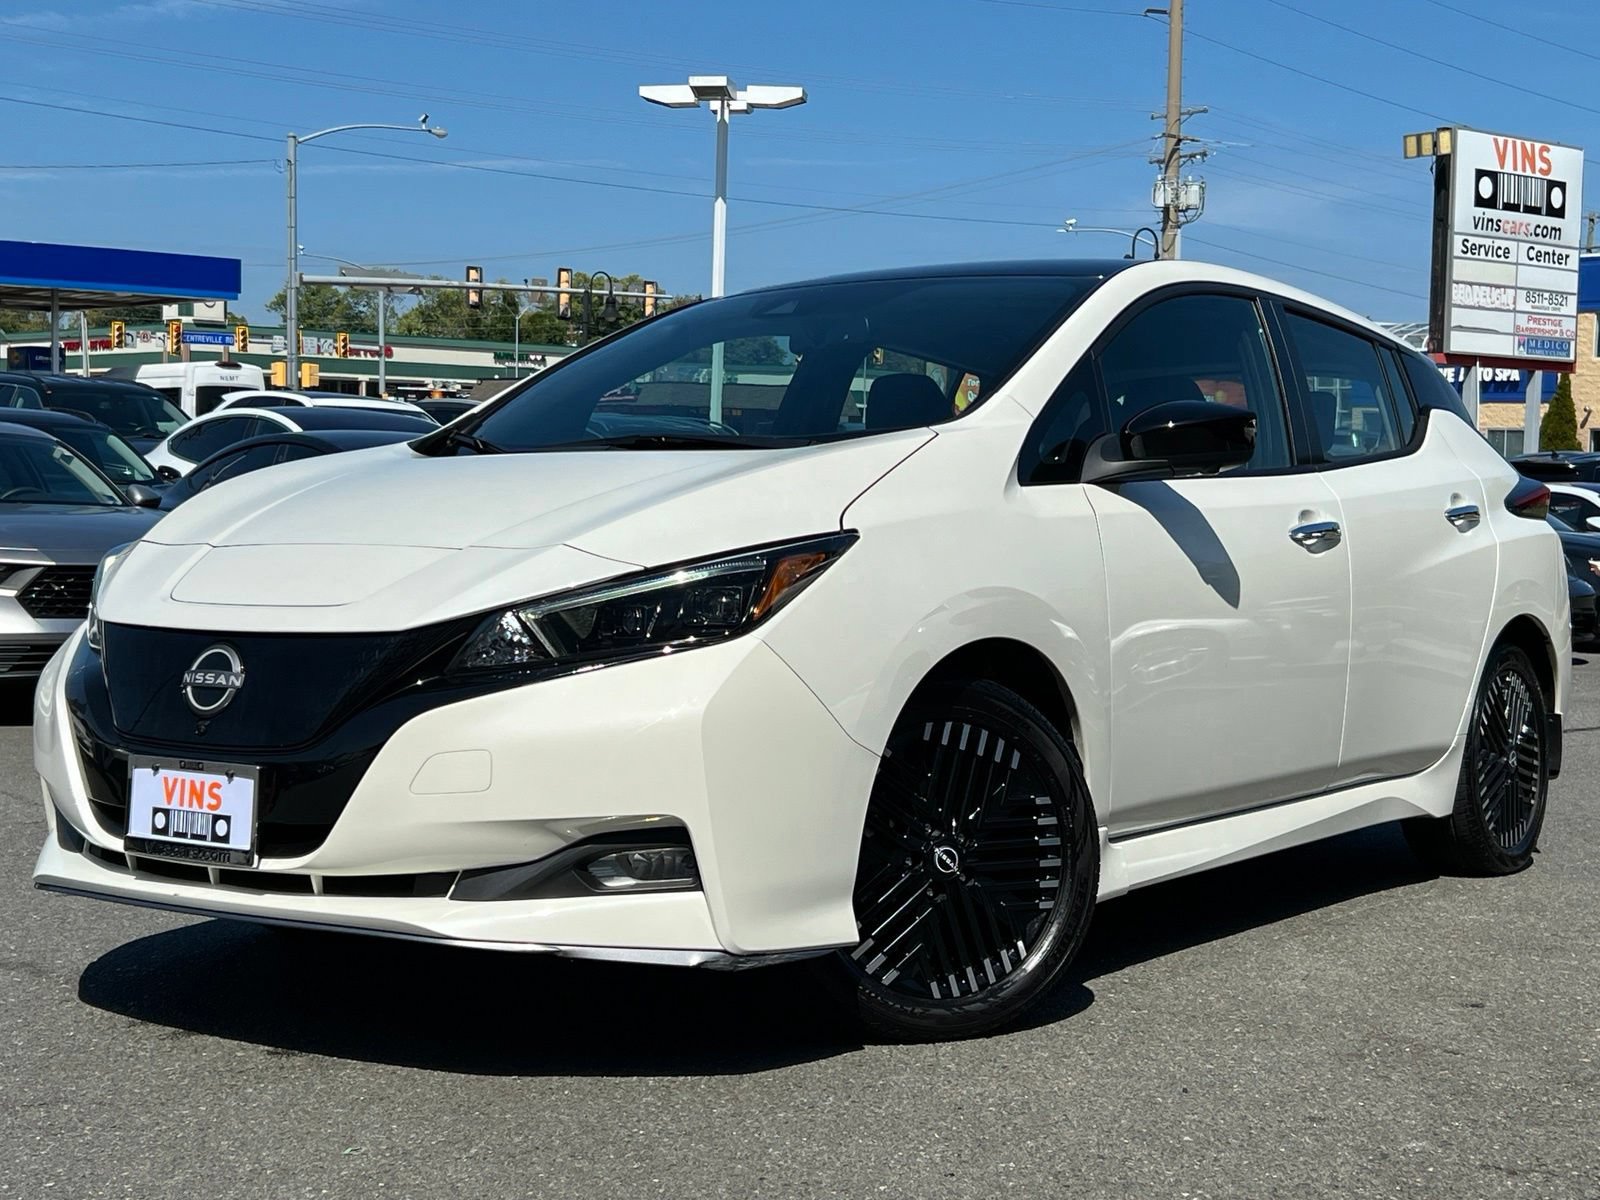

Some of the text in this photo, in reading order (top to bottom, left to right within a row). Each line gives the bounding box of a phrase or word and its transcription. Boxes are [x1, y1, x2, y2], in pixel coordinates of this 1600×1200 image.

[1492, 137, 1552, 176] VINS
[1473, 211, 1562, 240] vinscars.com
[1461, 239, 1570, 266] Service Center
[1525, 290, 1568, 307] 8511-8521
[1529, 339, 1569, 350] MEDICO
[1495, 367, 1521, 382] SPA
[183, 672, 242, 687] NISSAN
[163, 776, 222, 811] VINS
